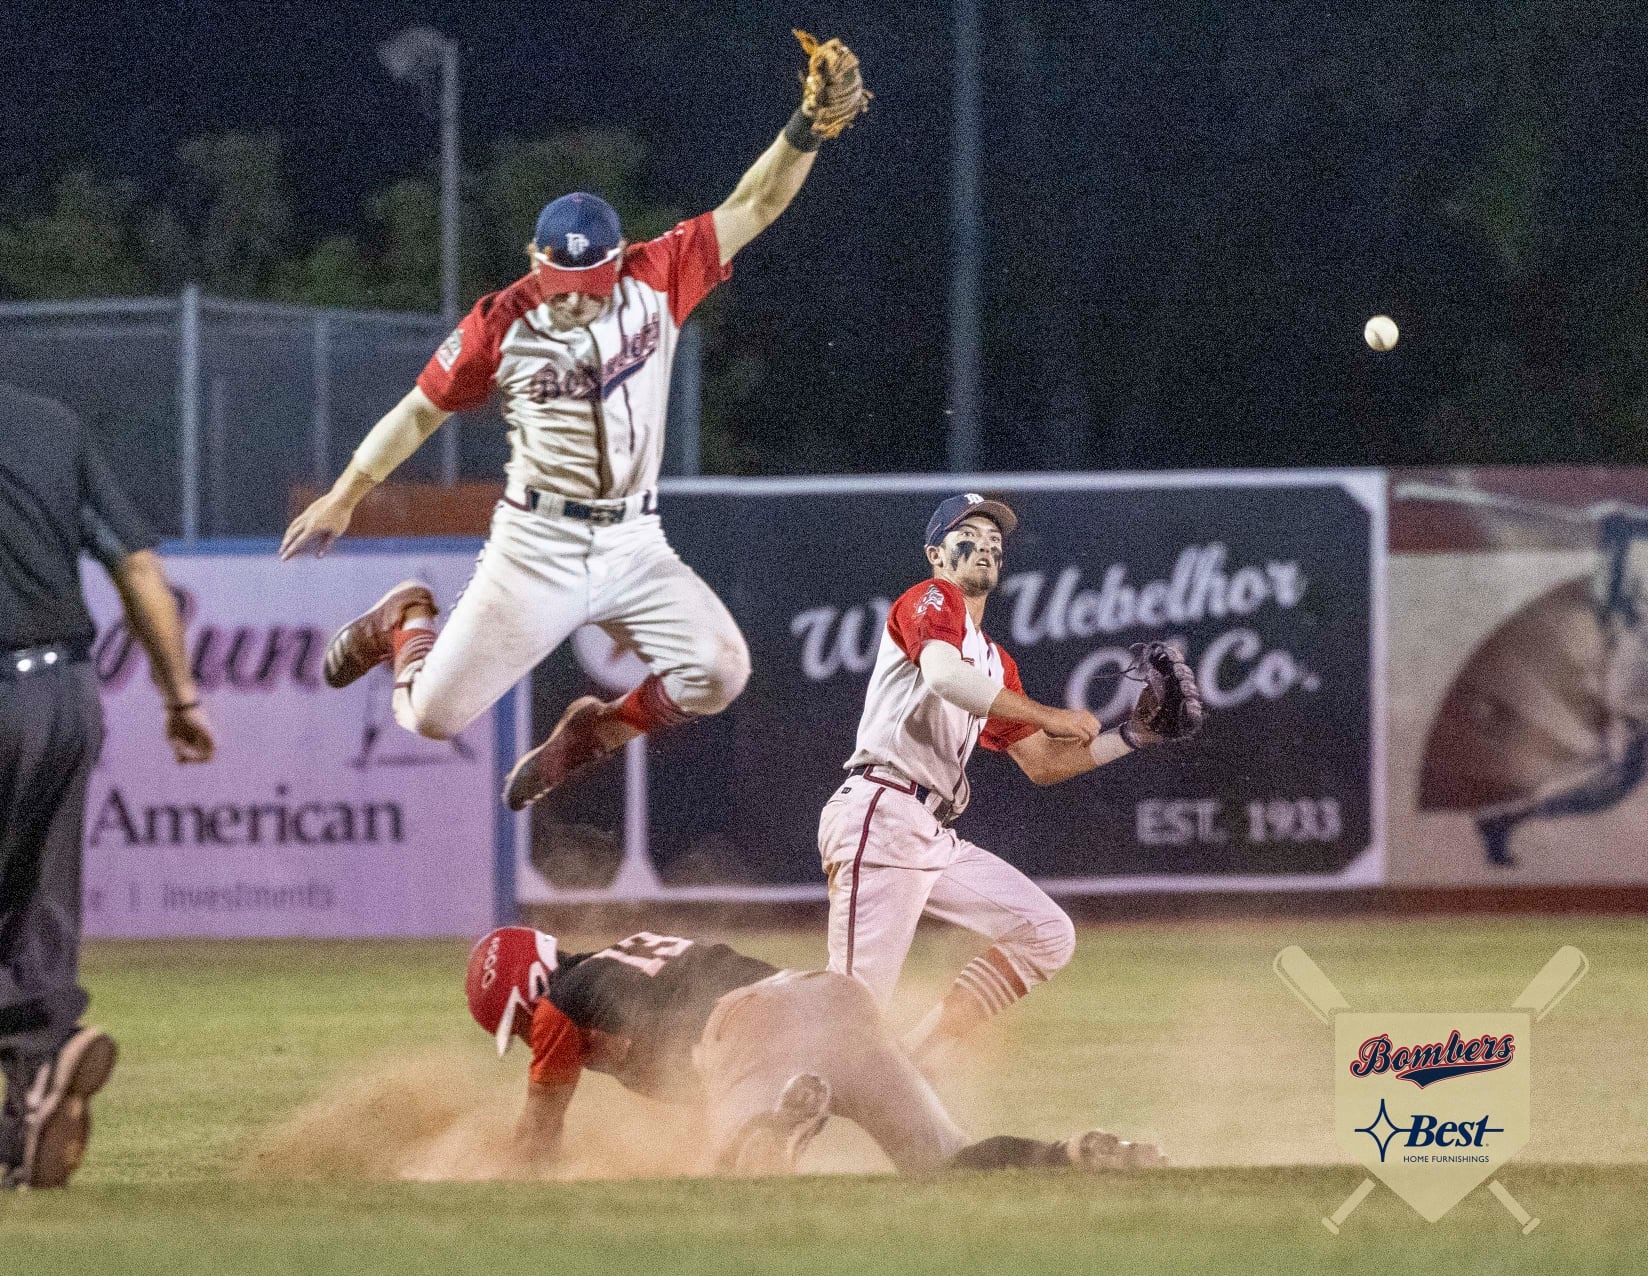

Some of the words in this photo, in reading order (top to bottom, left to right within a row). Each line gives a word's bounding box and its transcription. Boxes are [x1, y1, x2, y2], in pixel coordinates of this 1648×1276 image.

[1002, 542, 1304, 645] Uebelhor
[1198, 627, 1322, 708] Co.
[88, 783, 405, 847] American
[1248, 797, 1342, 843] 1933
